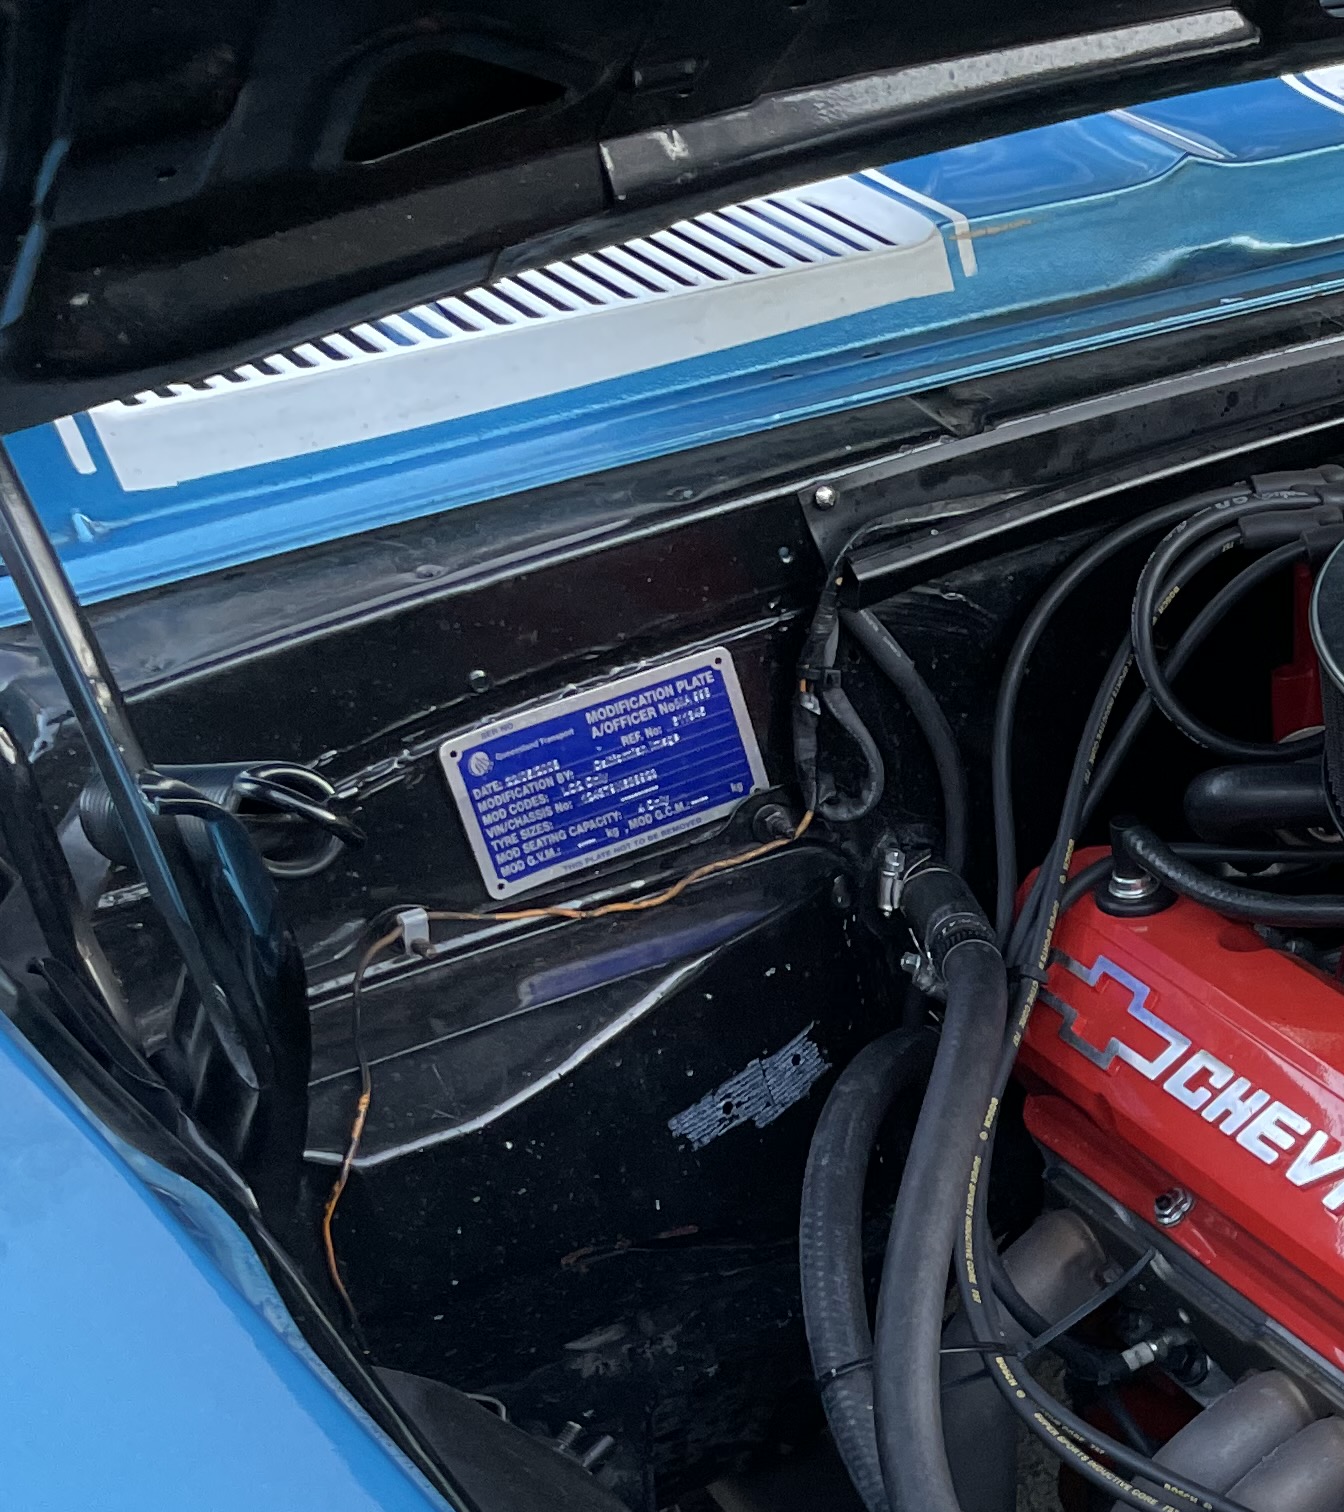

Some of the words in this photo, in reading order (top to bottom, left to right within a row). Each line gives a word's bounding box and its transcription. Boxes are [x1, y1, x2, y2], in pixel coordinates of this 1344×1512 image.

[584, 682, 675, 725] MODIFICATION
[674, 669, 715, 694] PLATE
[538, 726, 575, 746] Transport
[588, 705, 658, 740] A/OFFICER
[619, 729, 644, 747] REF.
[643, 723, 663, 739] No:
[471, 778, 504, 800] DATE:
[476, 775, 555, 812] MODIFICATION
[555, 768, 575, 784] BY:
[480, 807, 508, 825] MOD
[507, 791, 550, 816] CODES:
[485, 804, 554, 839] VIN/CHASSIS
[553, 797, 573, 814] No:
[490, 832, 519, 852] TYRE
[519, 819, 554, 840] SIZES:
[495, 845, 522, 865] MOD
[521, 828, 568, 855] SEATING
[567, 808, 623, 839] CAPACITY:
[500, 858, 526, 877] MOD
[604, 824, 621, 840] kg
[627, 811, 654, 831] MOD
[729, 778, 745, 795] kg
[995, 1356, 1017, 1387] BOSCH
[1034, 1412, 1058, 1437] SUPER
[1056, 1436, 1089, 1462] SPORTS
[1088, 1460, 1133, 1491] INDUCTIVE
[1131, 1489, 1158, 1505] CORE
